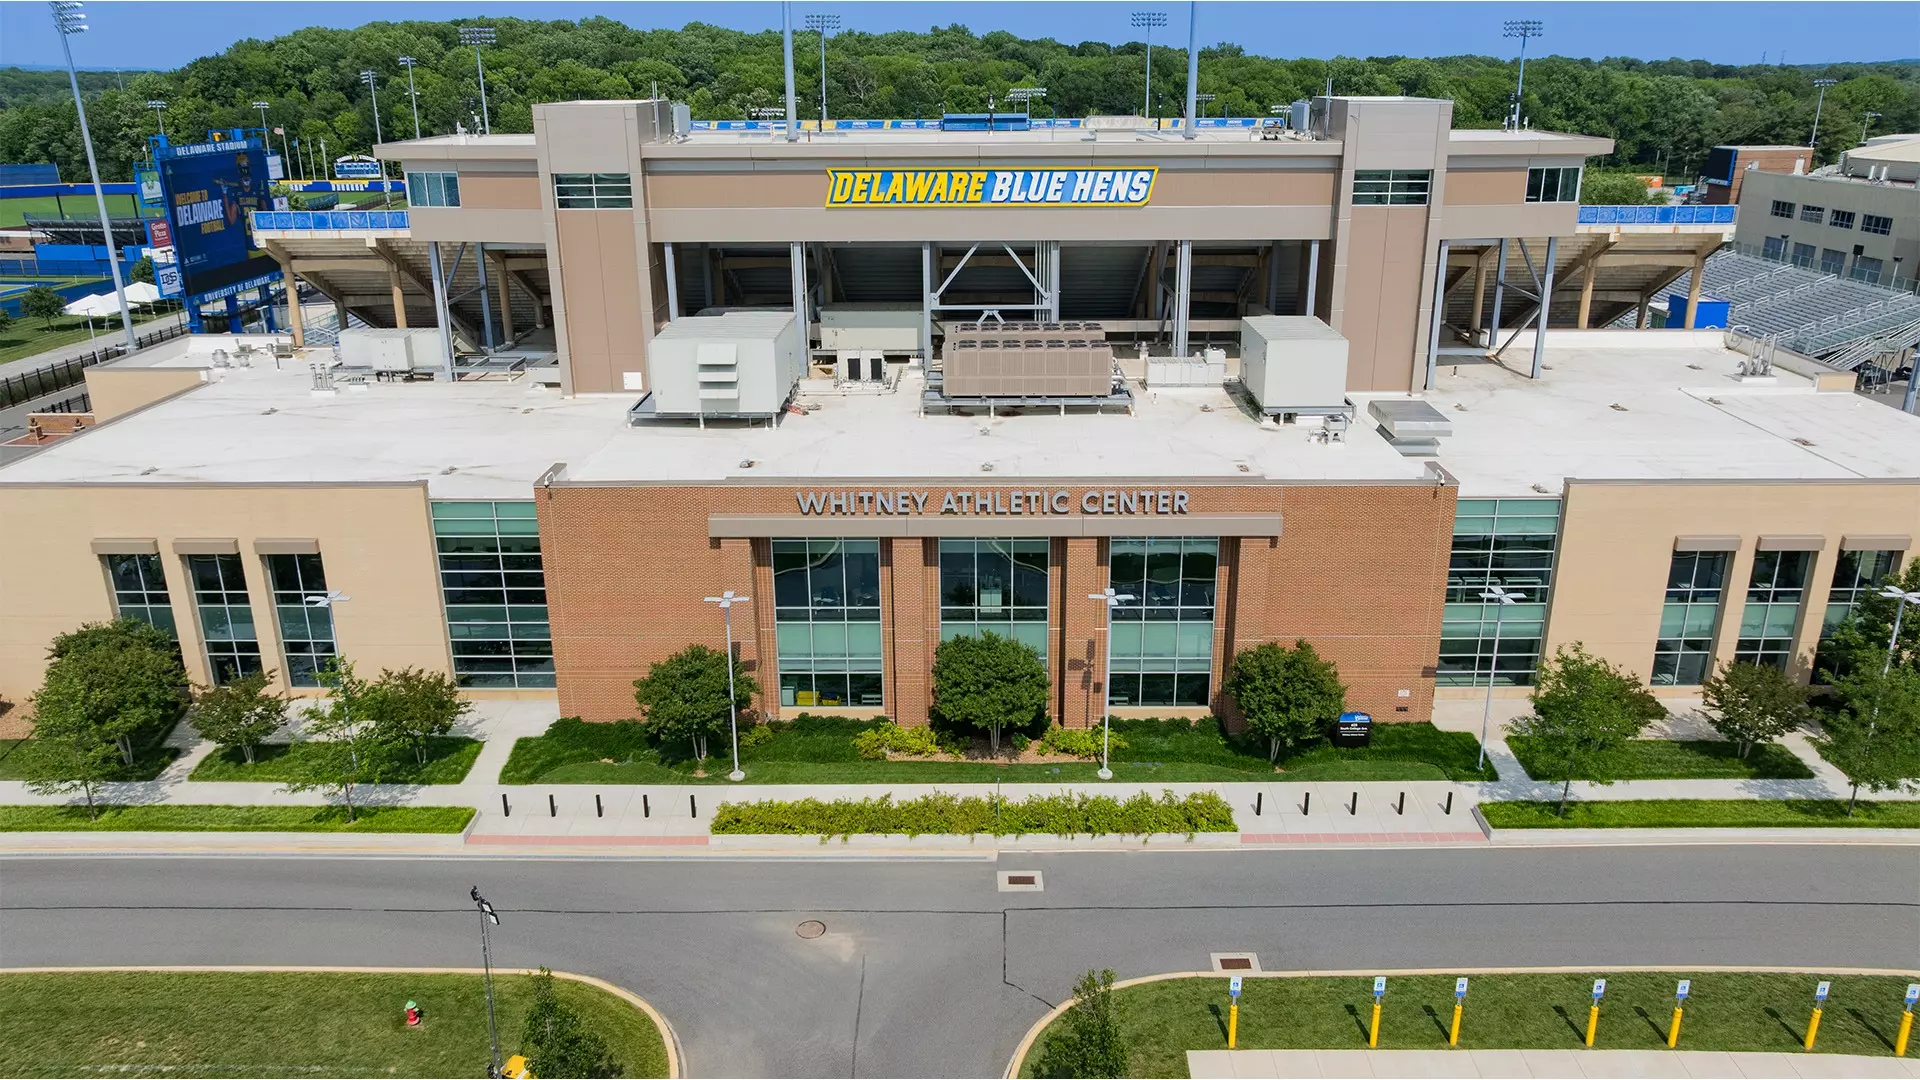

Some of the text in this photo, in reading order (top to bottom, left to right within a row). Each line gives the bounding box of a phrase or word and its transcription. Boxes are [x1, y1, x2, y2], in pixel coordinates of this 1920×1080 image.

[176, 140, 248, 156] DELAWARE STADIUM
[175, 191, 201, 204] WELCOME
[833, 171, 1151, 202] DELAWARE BLUE HENS
[176, 199, 224, 227] DELAWARE
[201, 219, 225, 235] FOOTBALL
[204, 275, 271, 302] UNIVERSITY OF DELAWARE
[796, 491, 1190, 514] WHITNEY ATHLETIC CENTER
